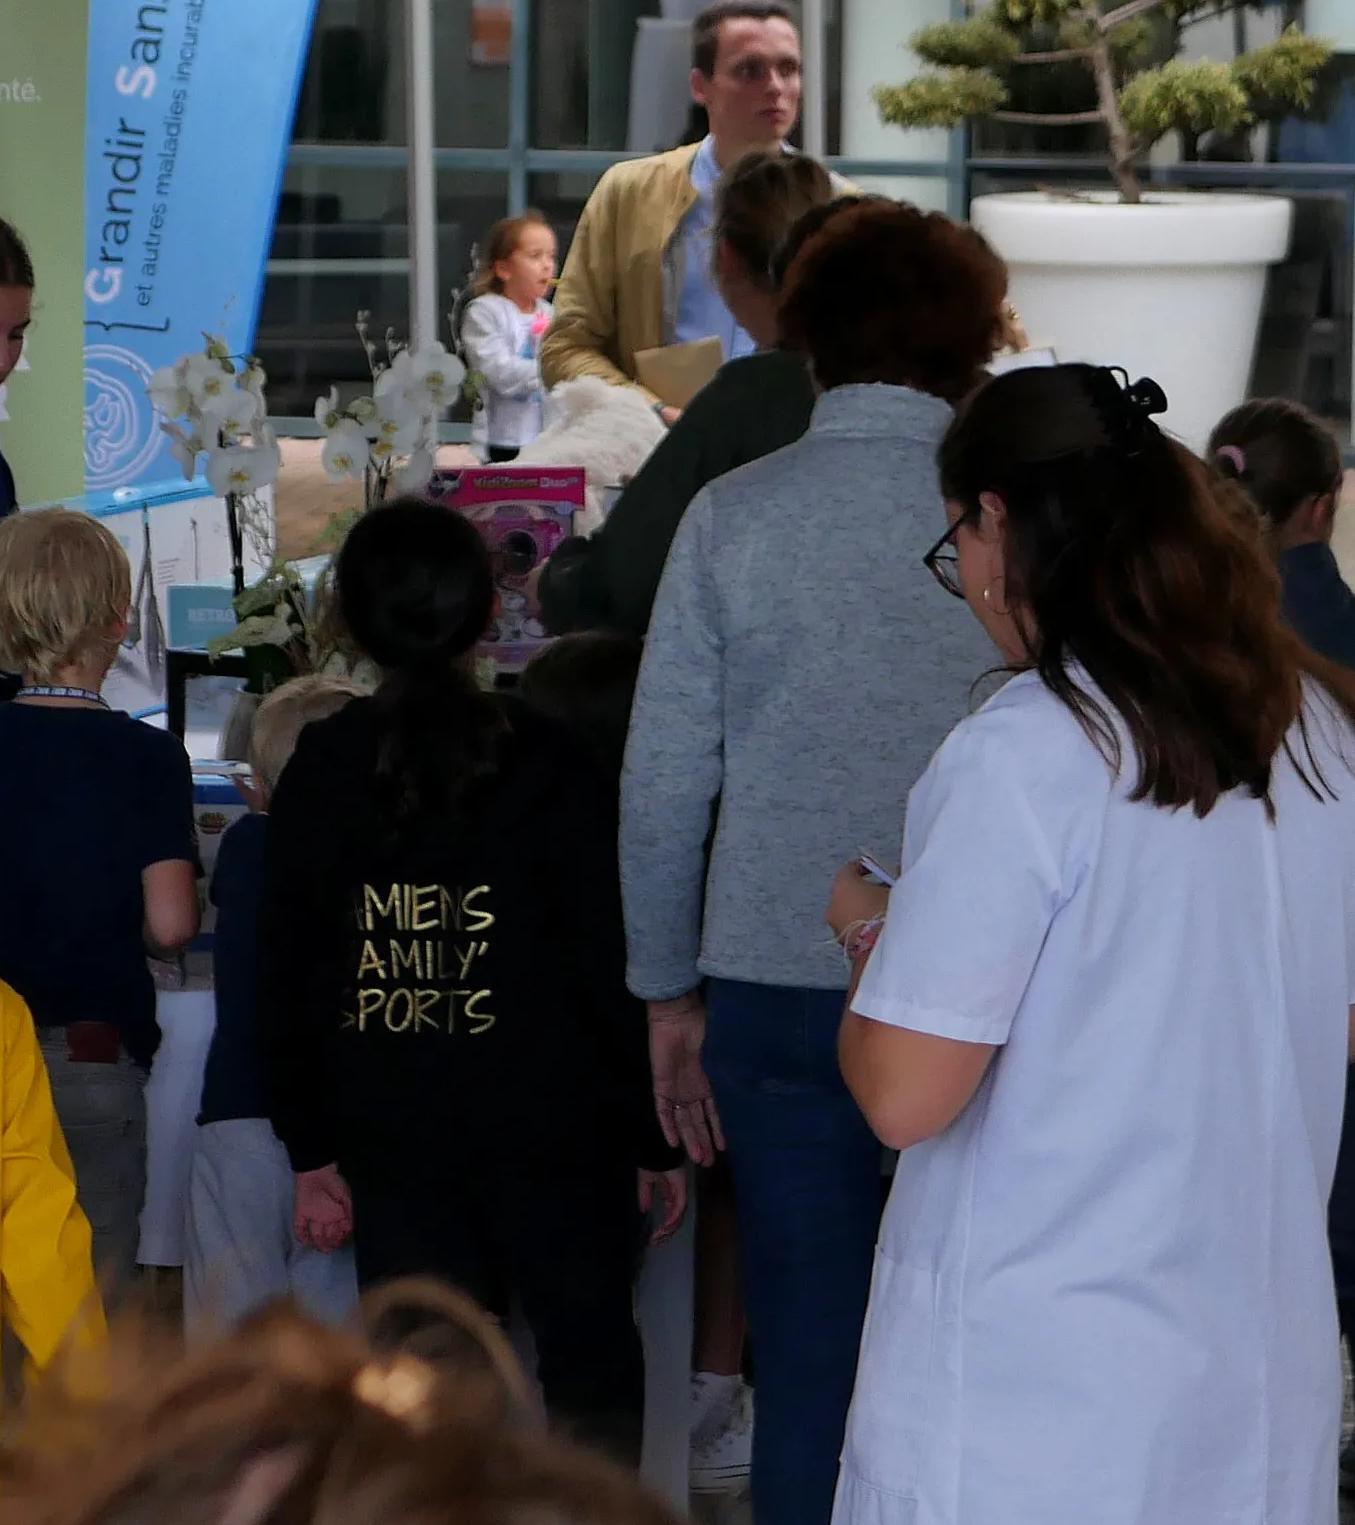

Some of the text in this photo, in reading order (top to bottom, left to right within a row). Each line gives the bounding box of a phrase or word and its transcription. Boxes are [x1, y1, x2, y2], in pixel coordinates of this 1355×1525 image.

[156, 89, 188, 196] maladies
[84, 116, 146, 304] Grandir
[142, 202, 167, 277] autres
[135, 284, 153, 307] et
